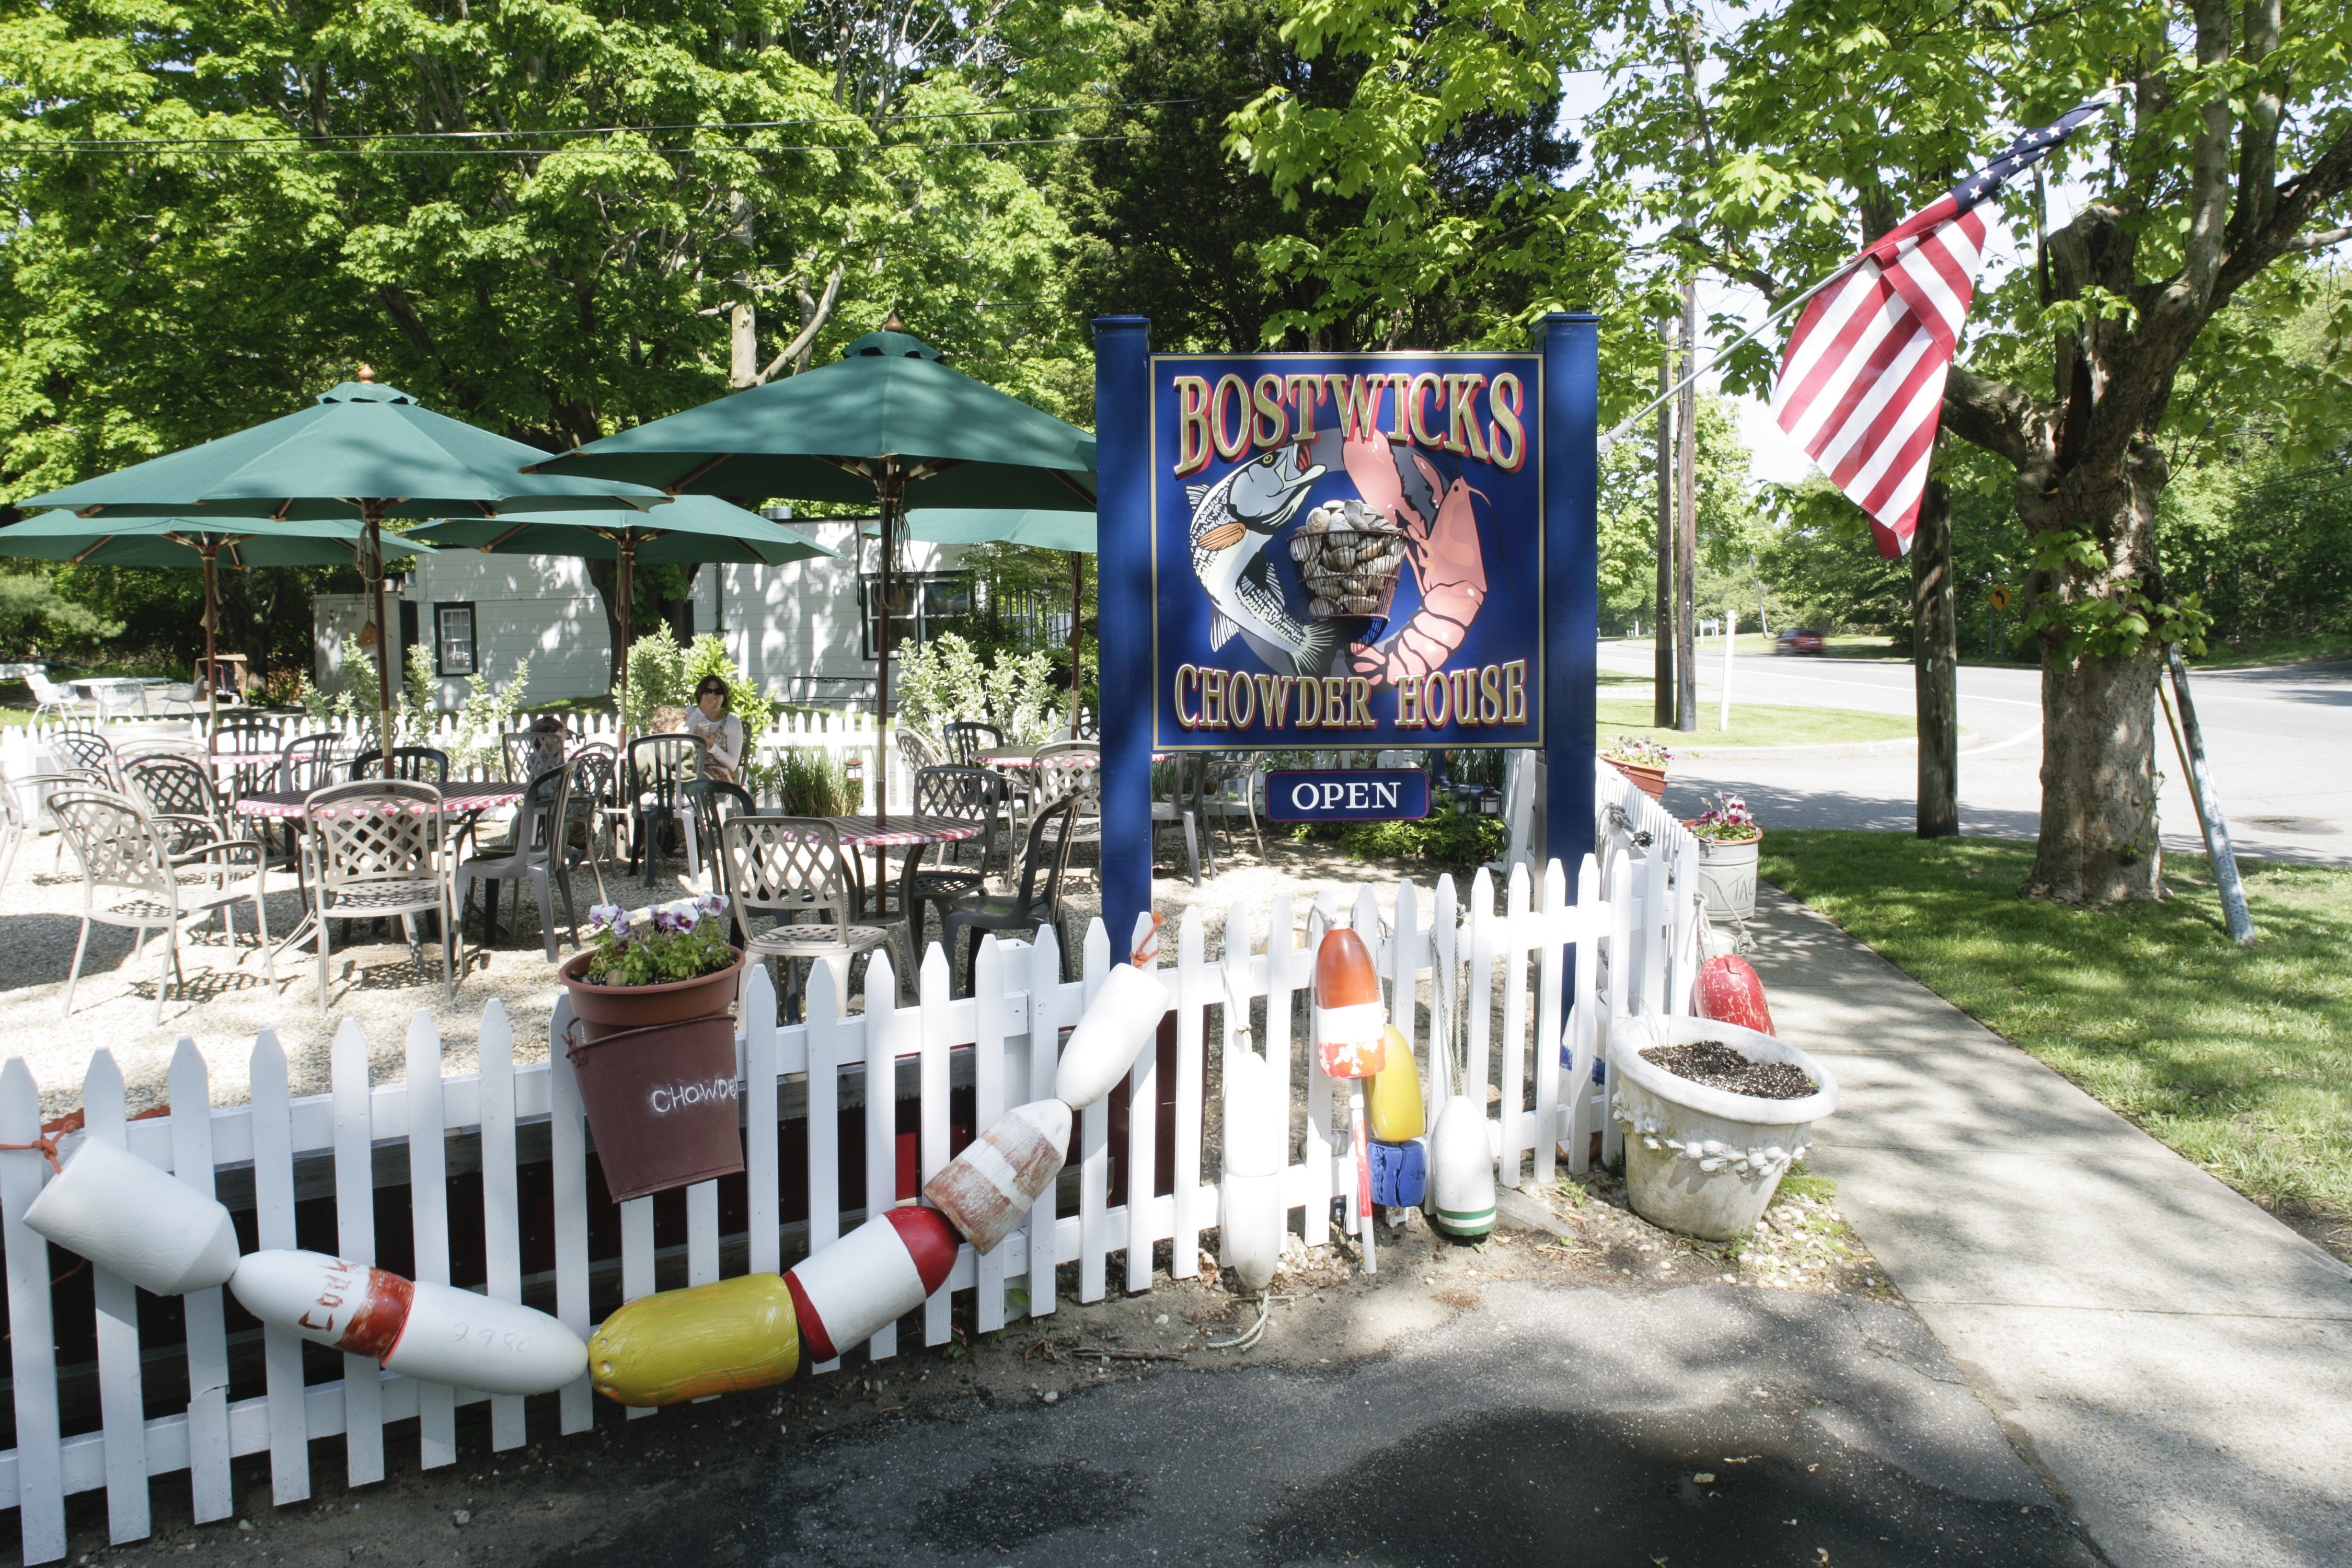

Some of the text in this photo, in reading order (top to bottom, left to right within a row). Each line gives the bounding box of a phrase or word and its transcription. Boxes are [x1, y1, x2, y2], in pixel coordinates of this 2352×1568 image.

[1173, 373, 1526, 478] BOSTWICKS
[1175, 658, 1527, 730] CHOWDER HOUSE
[1292, 781, 1401, 810] OPEN
